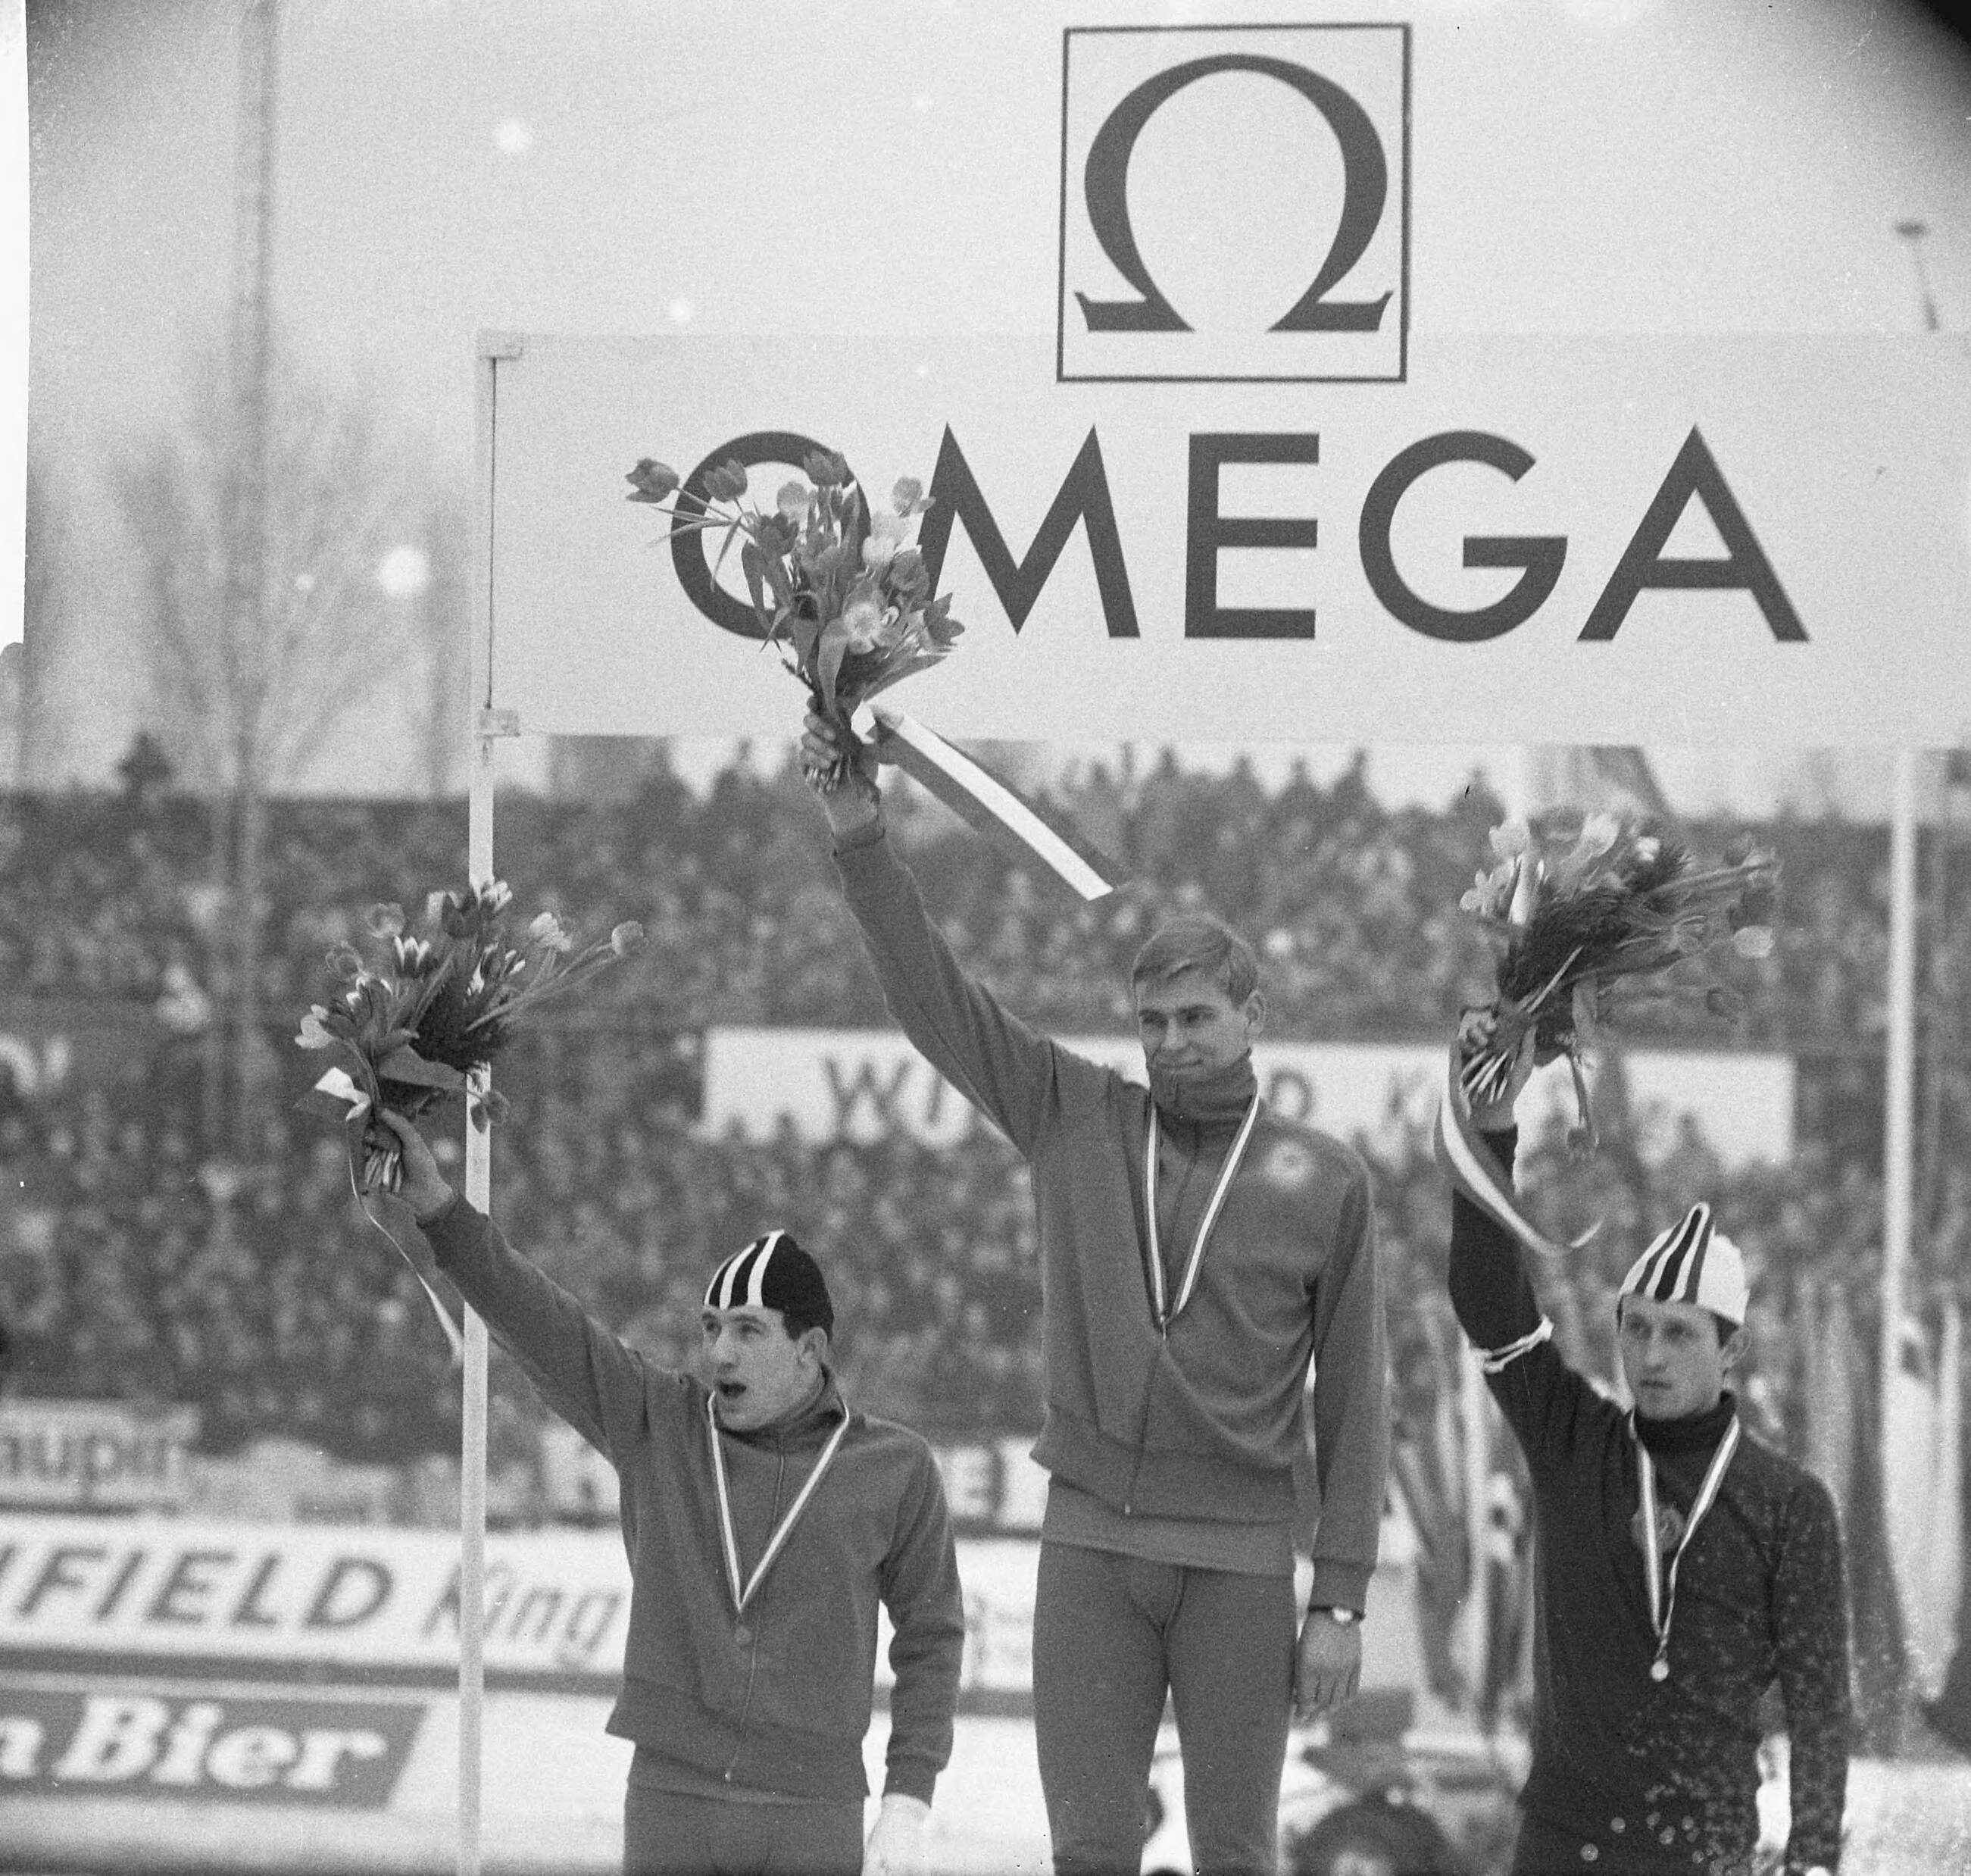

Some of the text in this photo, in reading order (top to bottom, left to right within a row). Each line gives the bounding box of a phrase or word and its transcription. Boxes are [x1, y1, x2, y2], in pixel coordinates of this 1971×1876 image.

[670, 422, 1810, 643] OMEGA
[0, 1544, 395, 1631] FIELD
[53, 1696, 388, 1790] Bier
